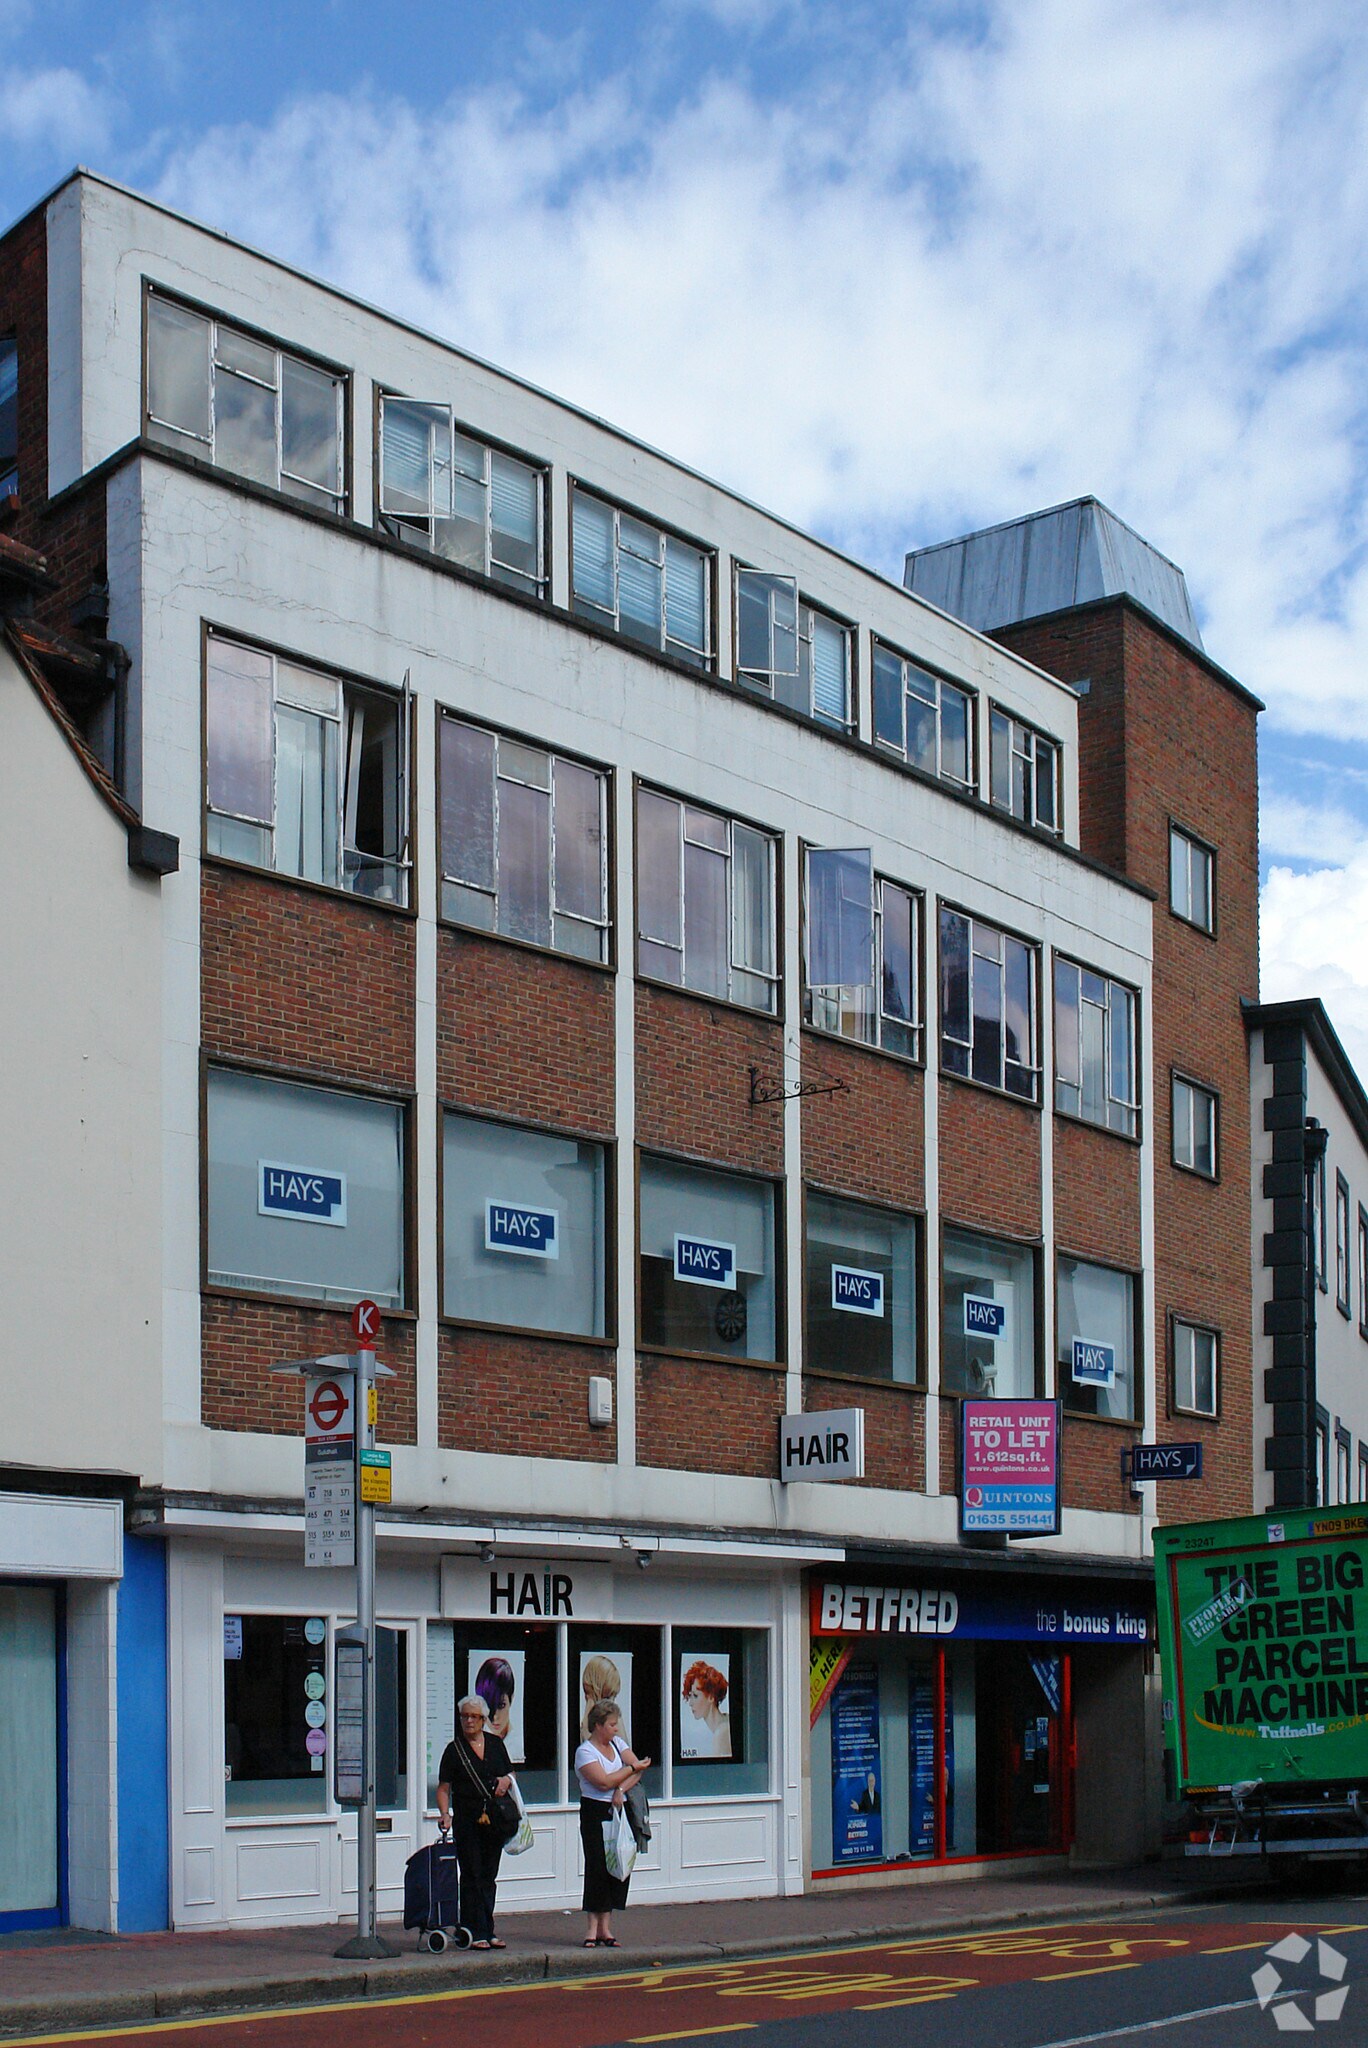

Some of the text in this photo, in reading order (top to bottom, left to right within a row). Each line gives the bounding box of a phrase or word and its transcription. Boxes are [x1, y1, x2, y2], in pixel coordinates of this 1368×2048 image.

[269, 1172, 325, 1203] HAYS
[495, 1210, 540, 1239] HAYS
[682, 1244, 721, 1271] HAYS
[838, 1275, 871, 1299] HAYS
[358, 1306, 373, 1335] K
[969, 1303, 996, 1325] HAYS
[1077, 1346, 1105, 1371] HAYS
[969, 1416, 1051, 1428] RETAIL UNIT
[970, 1431, 1050, 1448] TO LET
[969, 1464, 1050, 1474] www.quintons.co.uk
[1140, 1450, 1182, 1469] HAYS
[965, 1487, 1052, 1508] QUINTONS
[968, 1513, 1052, 1525] 01635 551441
[1315, 1520, 1342, 1533] YN09
[1184, 1537, 1215, 1549] 2324T
[1204, 1551, 1364, 1601] THE BIG
[820, 1583, 959, 1634] BETFRED
[1188, 1592, 1235, 1632] PEOPLE
[1221, 1594, 1355, 1643] GREEN
[1037, 1609, 1147, 1640] the bonus king
[1216, 1636, 1368, 1684] PARCEL
